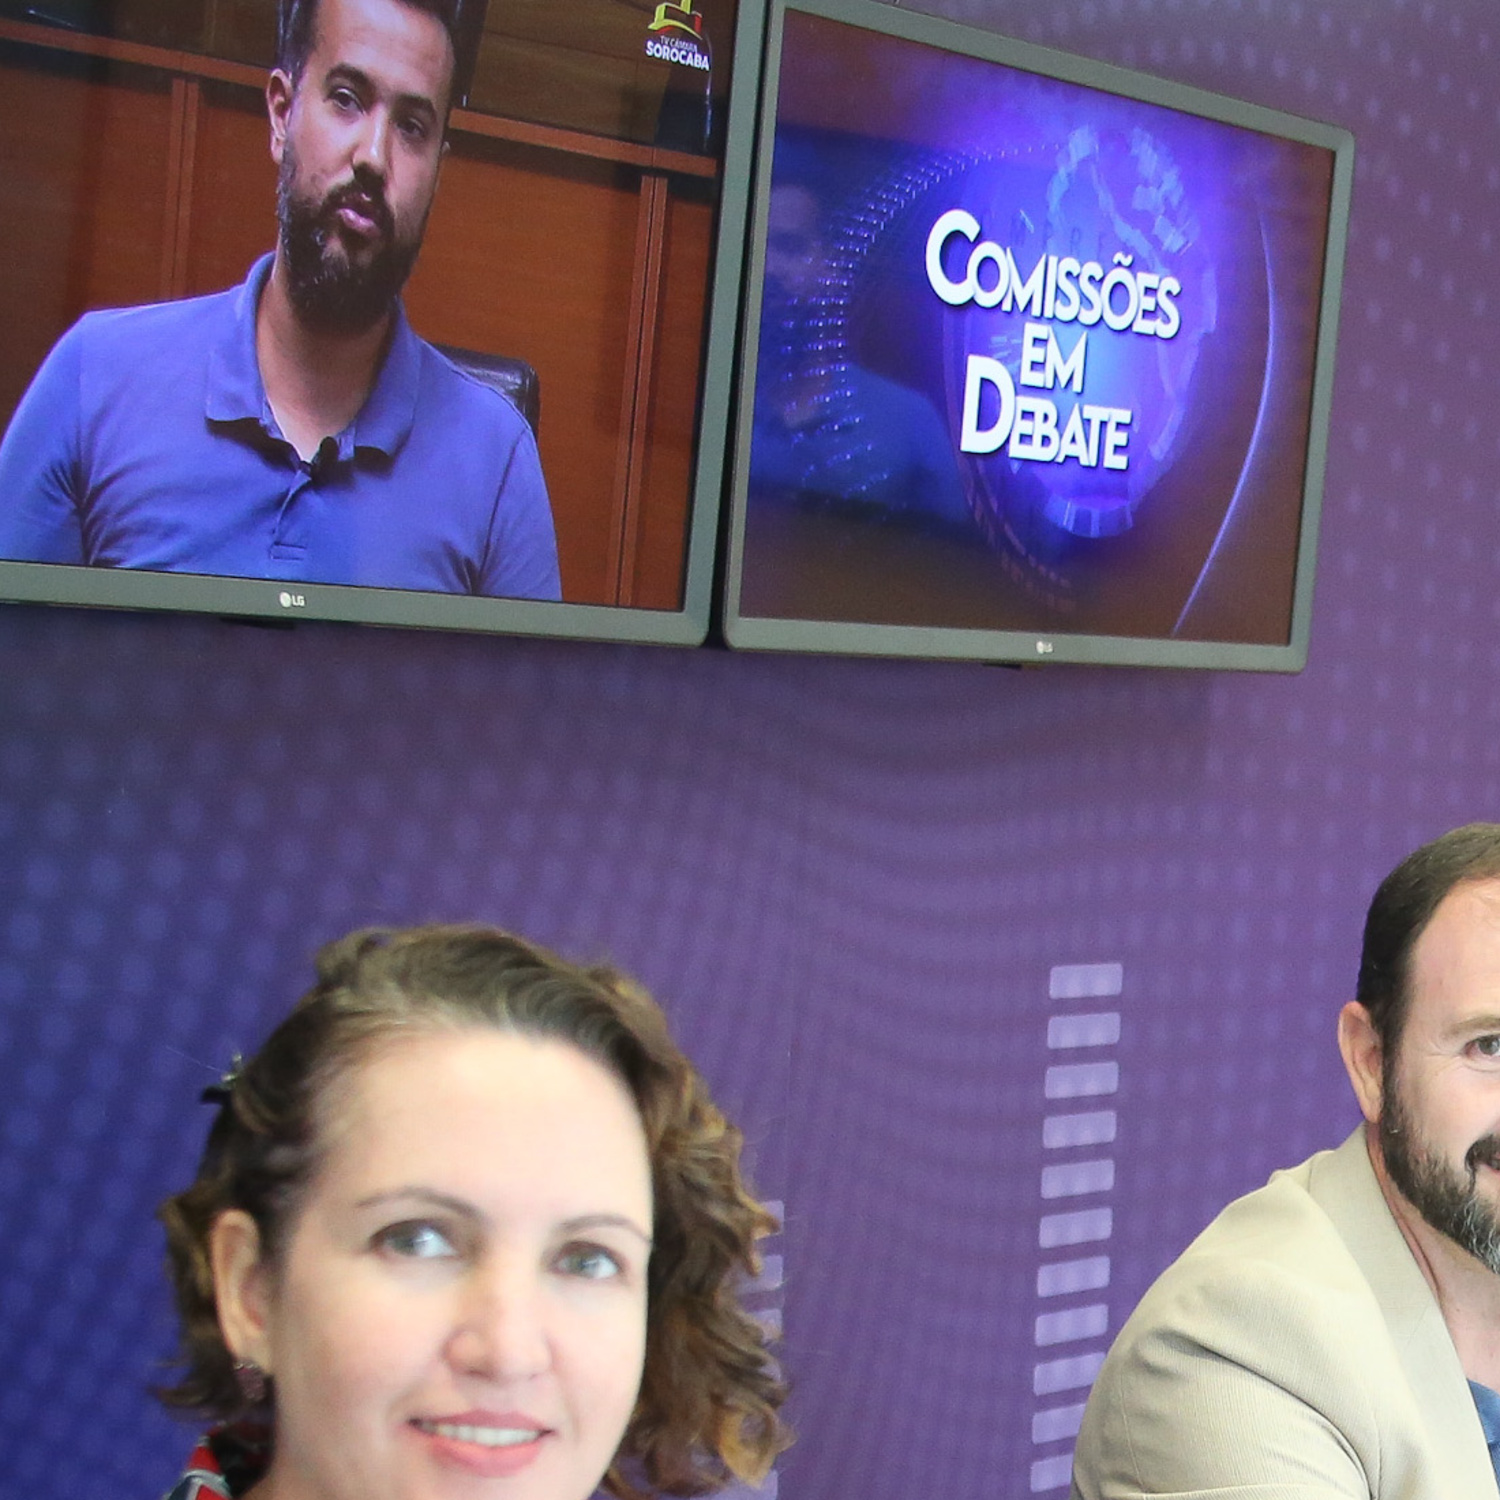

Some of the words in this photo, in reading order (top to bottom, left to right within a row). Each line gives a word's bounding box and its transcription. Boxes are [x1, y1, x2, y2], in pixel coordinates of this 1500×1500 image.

[646, 40, 710, 71] SOROCABA
[926, 208, 1182, 339] COMISSÕES
[1020, 321, 1088, 393] EM
[960, 354, 1132, 470] DEBATE
